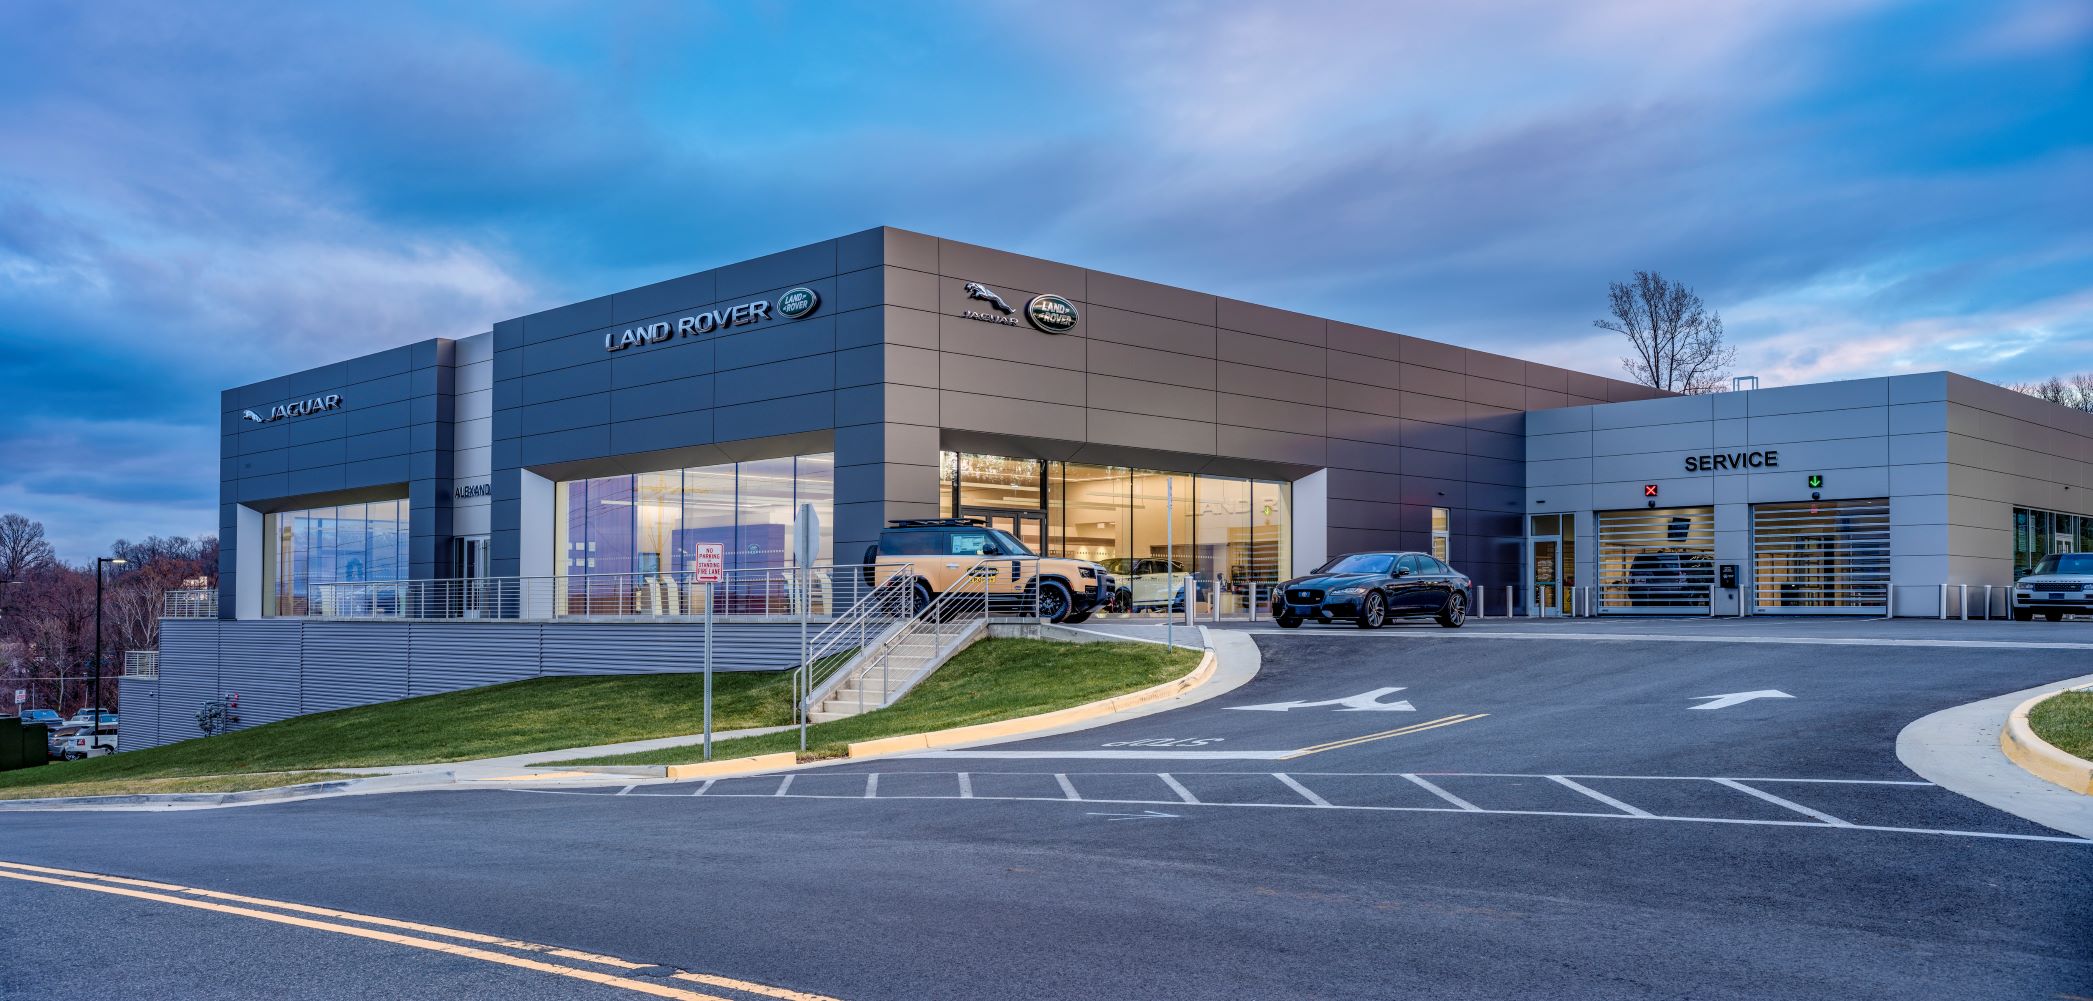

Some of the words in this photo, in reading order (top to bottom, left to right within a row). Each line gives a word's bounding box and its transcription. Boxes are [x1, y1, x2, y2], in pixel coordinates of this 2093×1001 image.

[785, 293, 803, 304] LAND
[786, 300, 808, 312] ROVER
[1042, 301, 1066, 313] LAND
[605, 321, 671, 352] LAND
[678, 300, 772, 337] ROVER
[963, 310, 1019, 327] JAGUAR
[1044, 312, 1072, 326] ROVER
[266, 394, 342, 422] JAGUAR
[1685, 451, 1778, 472] SERVICE
[455, 484, 491, 499] ALEXAND
